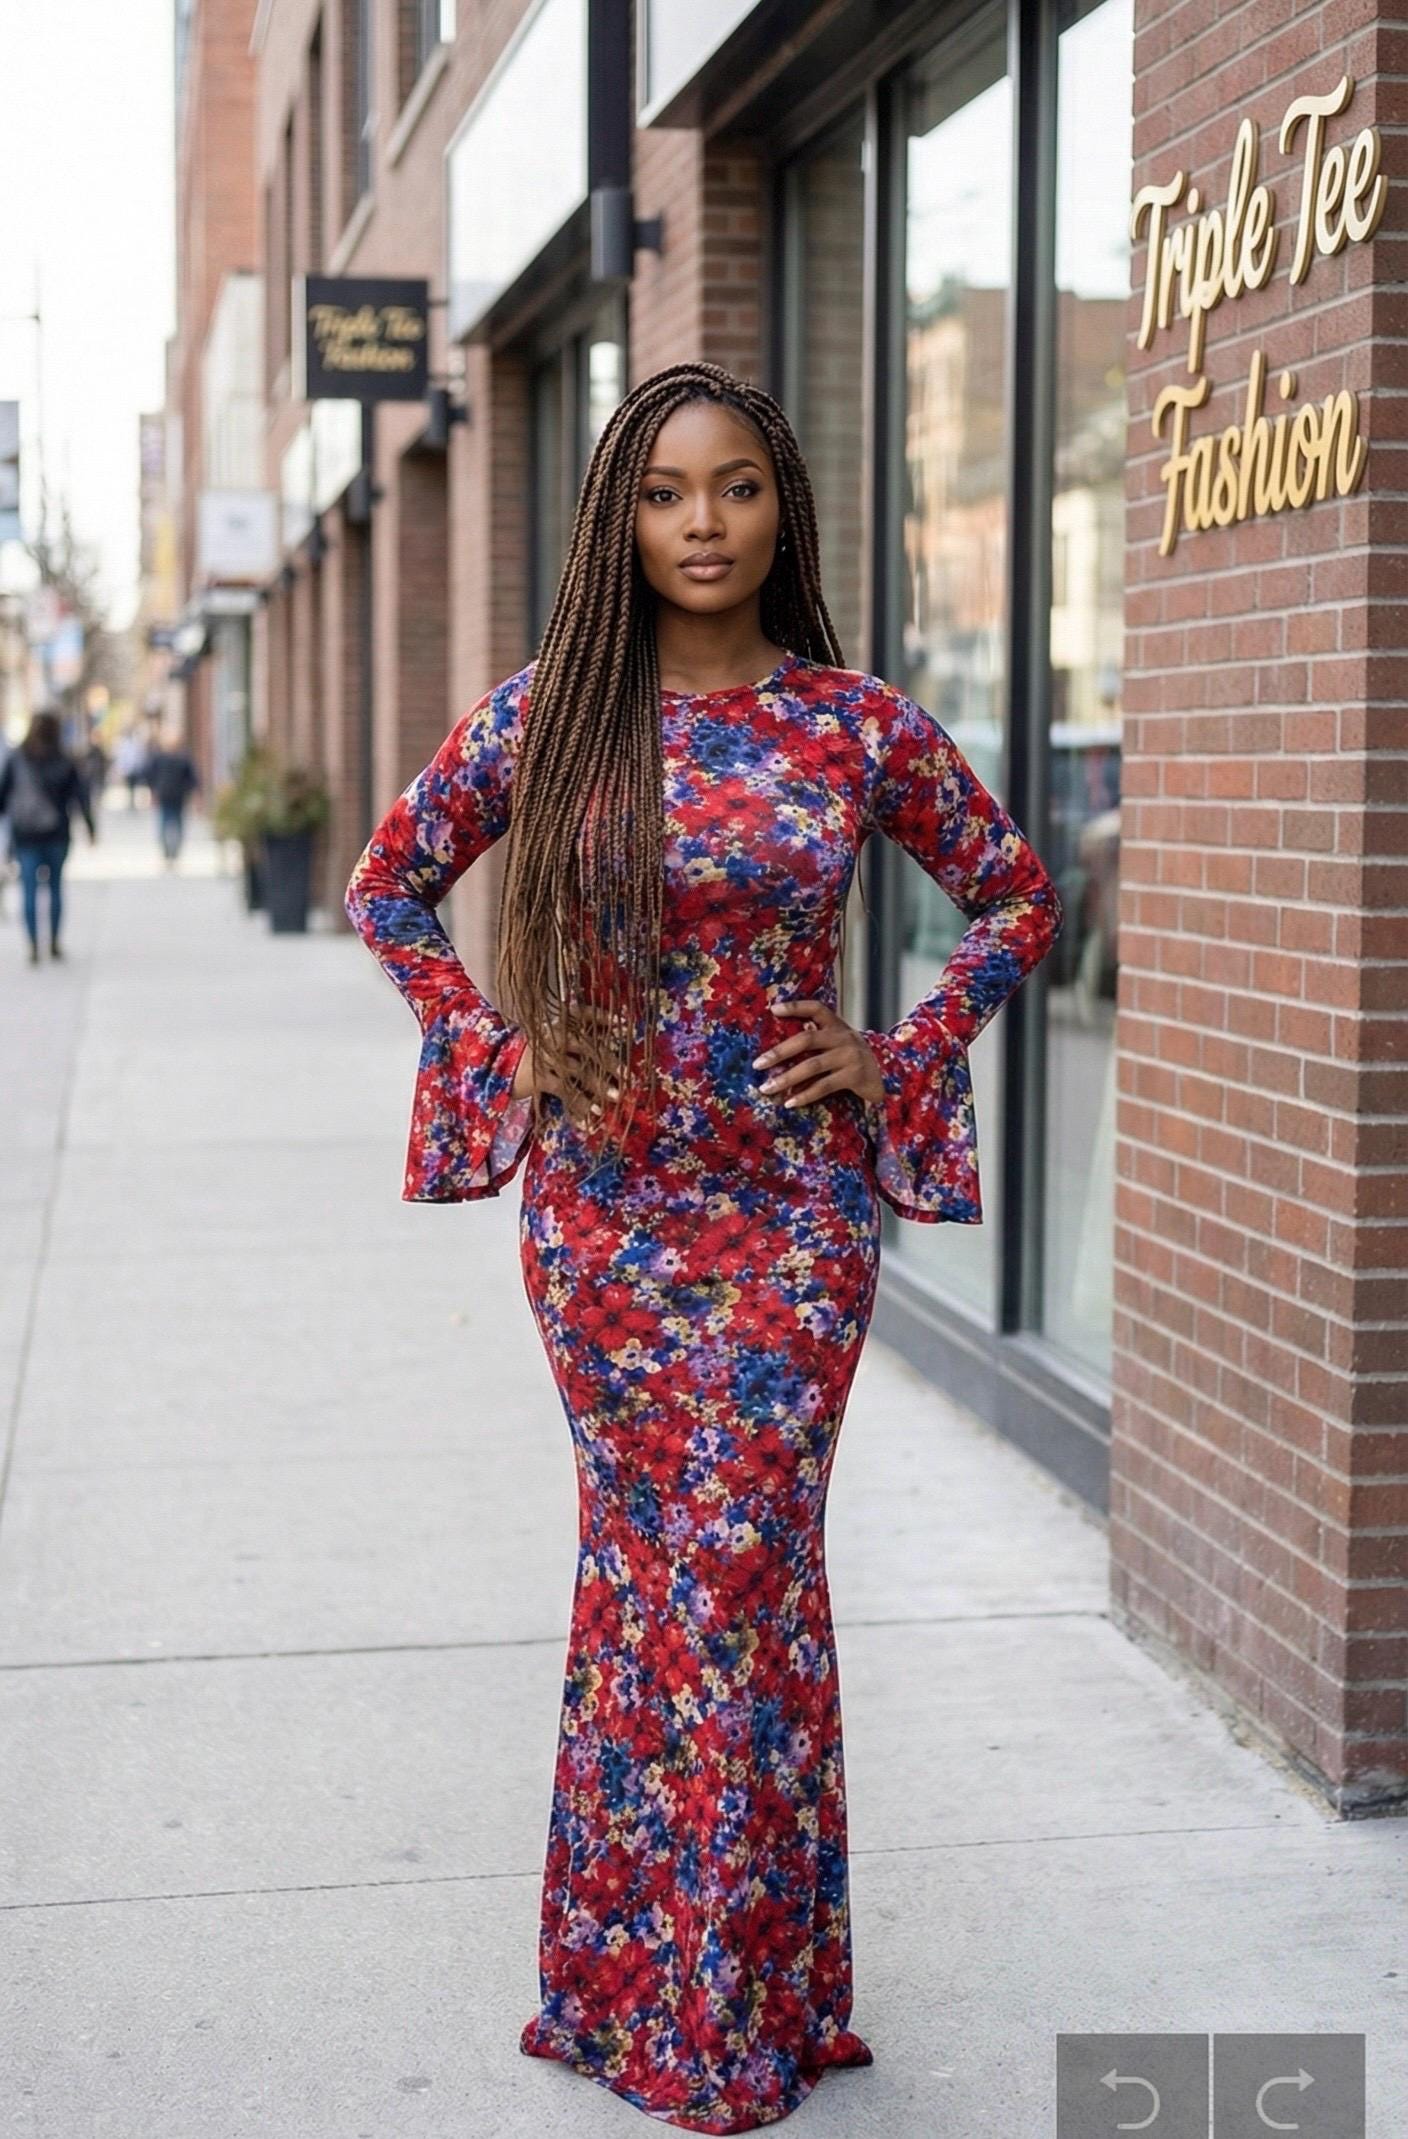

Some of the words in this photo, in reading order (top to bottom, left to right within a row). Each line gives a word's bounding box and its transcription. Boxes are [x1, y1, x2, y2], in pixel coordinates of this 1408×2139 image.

[1131, 117, 1279, 374] Triple
[1279, 75, 1388, 285] Tee
[1152, 350, 1367, 556] Fashion
